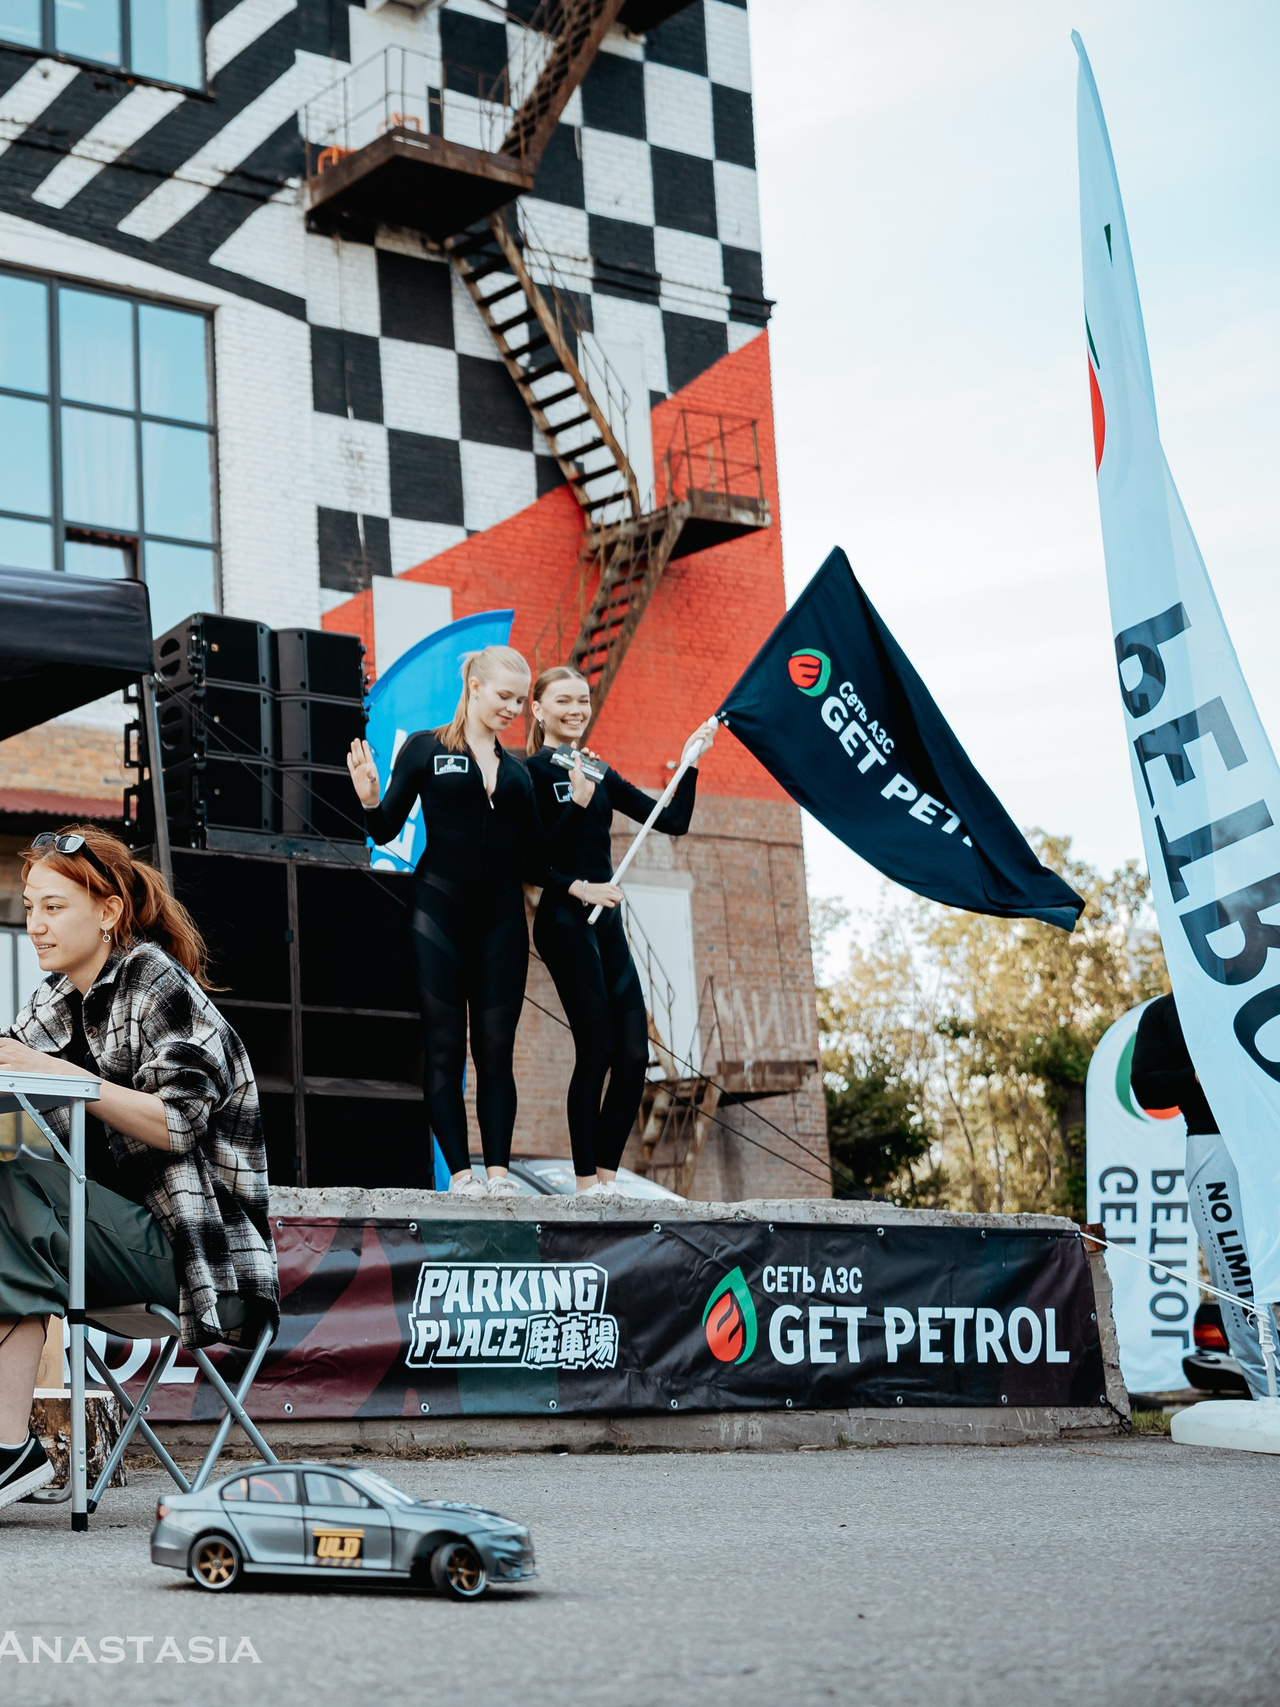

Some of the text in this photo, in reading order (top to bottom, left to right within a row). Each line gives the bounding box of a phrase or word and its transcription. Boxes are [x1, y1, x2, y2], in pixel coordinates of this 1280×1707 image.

[839, 681, 895, 755] Сеть АЗС
[820, 696, 973, 848] GET PET
[1206, 1181, 1233, 1223] NO
[419, 1268, 599, 1314] PARKING
[762, 1265, 863, 1294] СЕТЬ АЗС
[413, 1318, 528, 1357] PLACE
[768, 1304, 1070, 1365] GET PETROL
